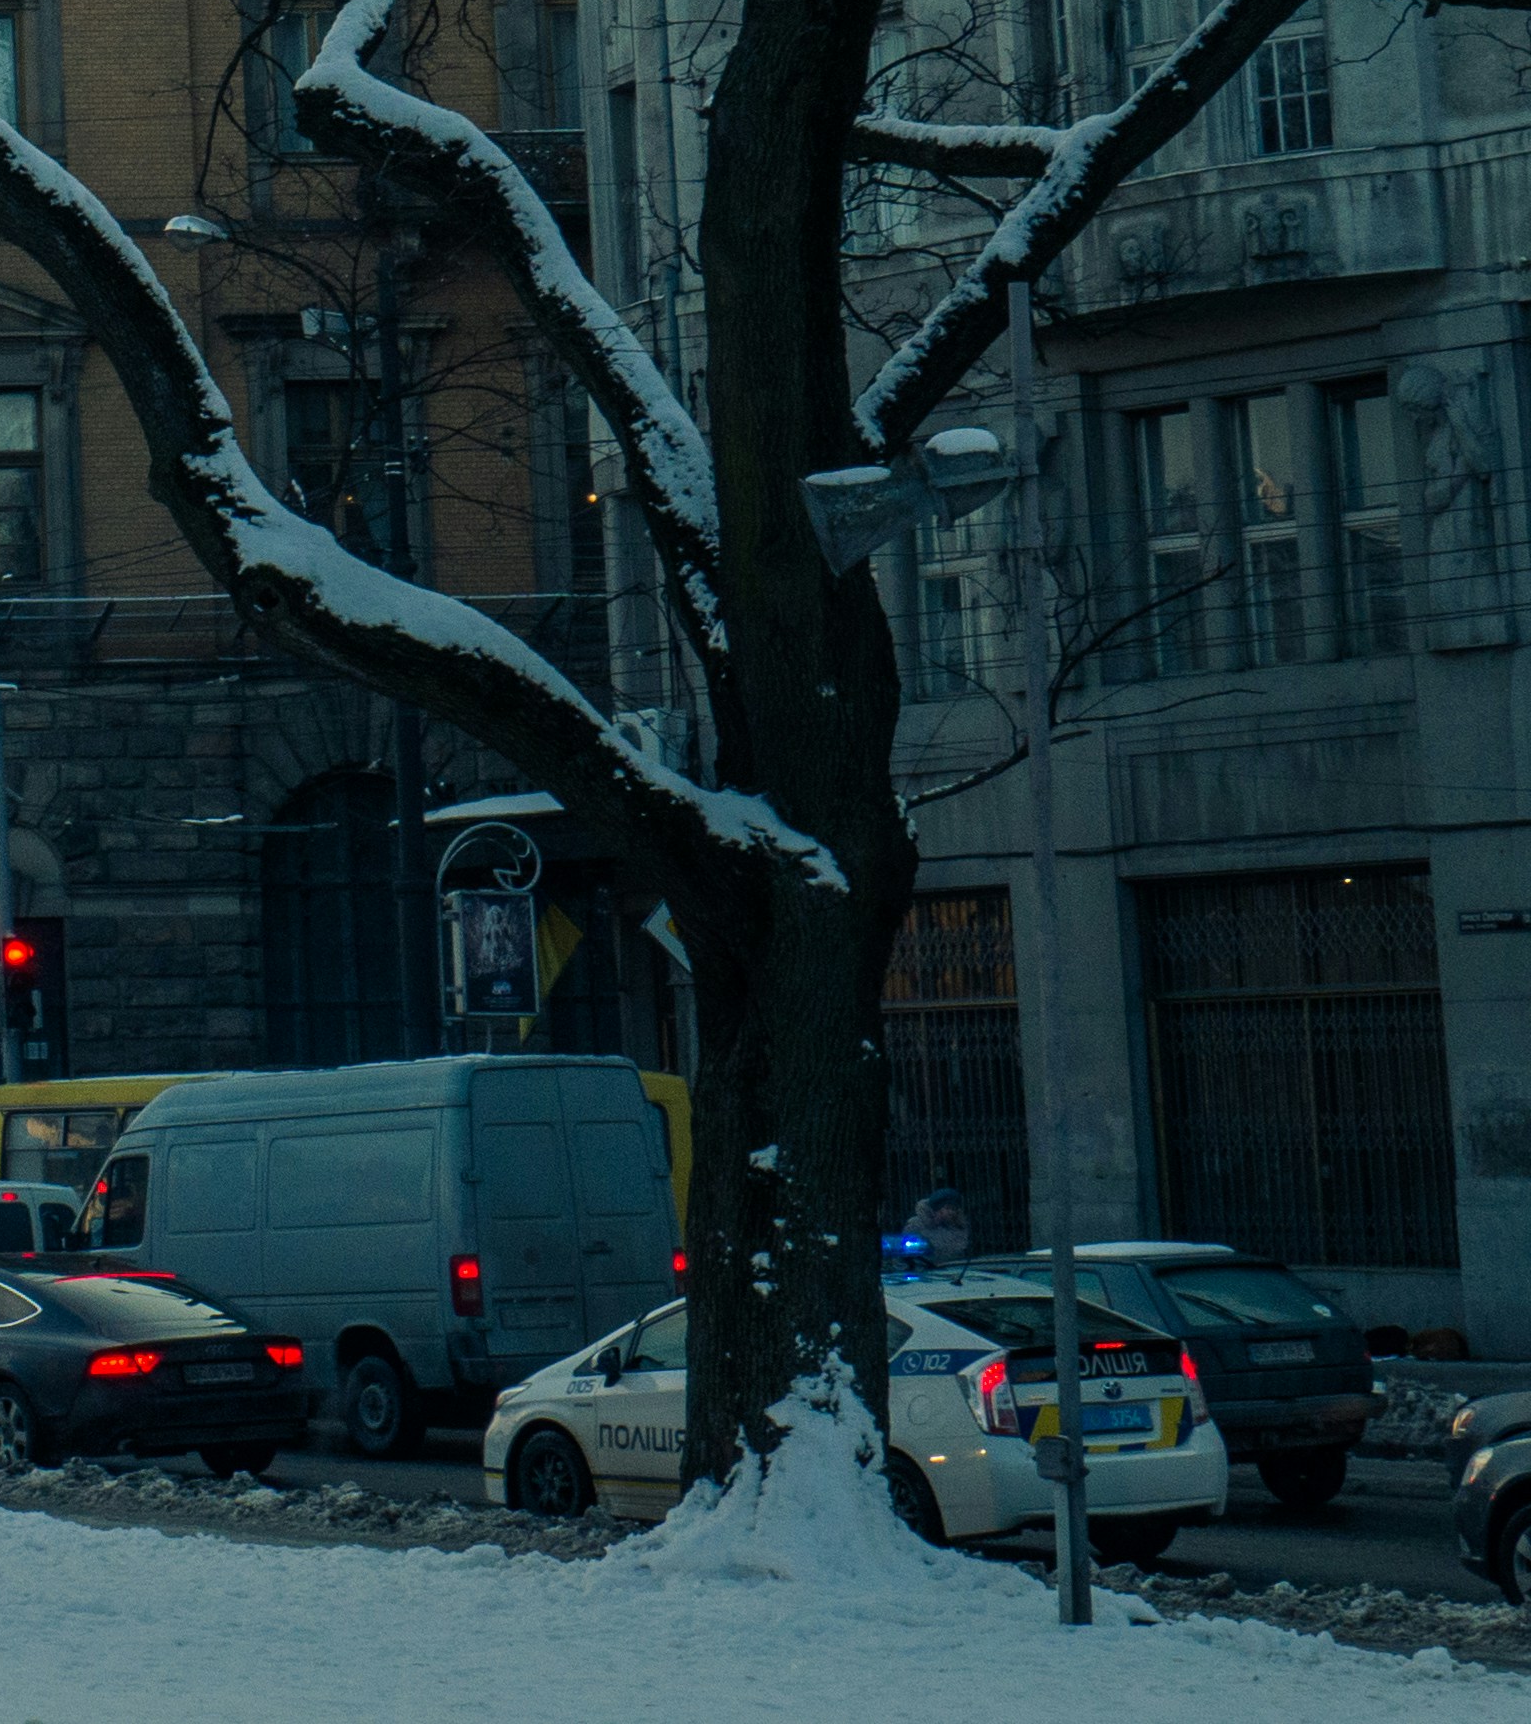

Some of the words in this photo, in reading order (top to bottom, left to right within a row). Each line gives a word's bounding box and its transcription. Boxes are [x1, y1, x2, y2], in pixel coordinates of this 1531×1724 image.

[923, 1354, 951, 1371] 102
[1078, 1352, 1148, 1376] ОЛІЦІЯ
[566, 1380, 597, 1395] 0105
[1109, 1409, 1142, 1427] 3754
[599, 1423, 687, 1453] ПОЛІЦІЯ
